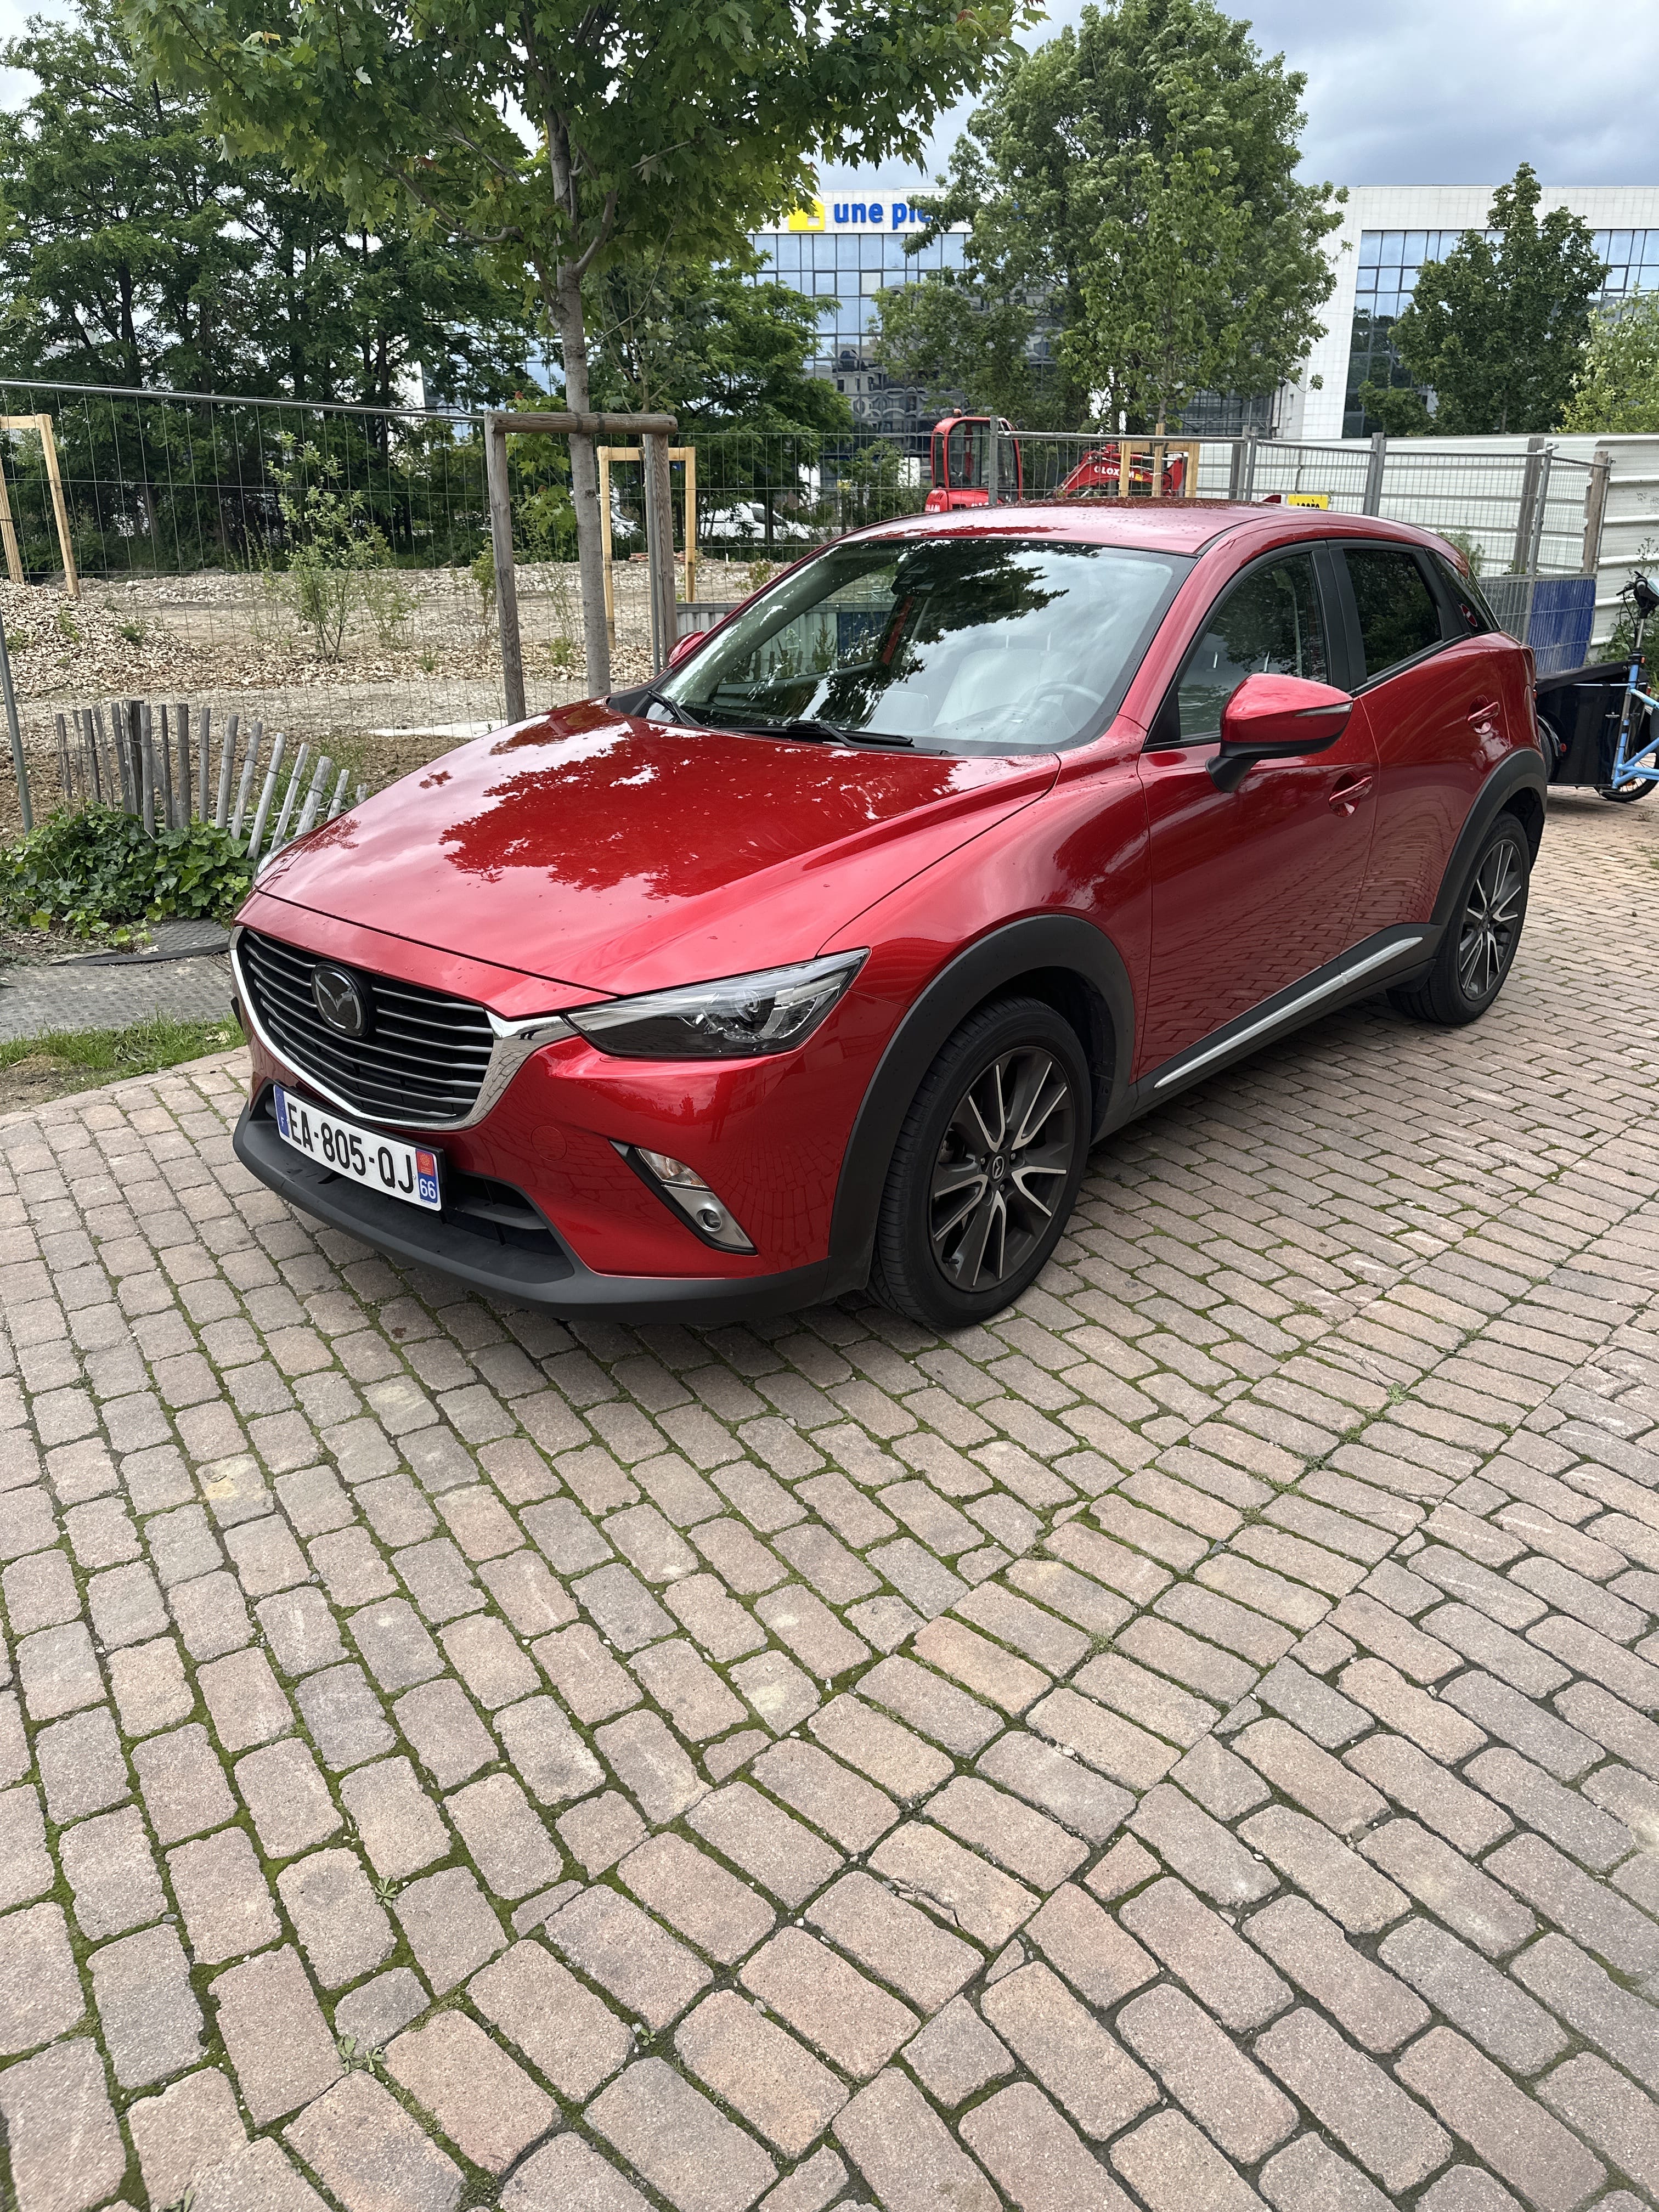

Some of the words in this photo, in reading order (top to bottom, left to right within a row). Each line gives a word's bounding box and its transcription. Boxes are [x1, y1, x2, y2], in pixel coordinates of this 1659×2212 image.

[834, 202, 883, 223] une
[280, 1116, 285, 1127] F
[287, 1102, 414, 1194] EA-805-QJ
[419, 1178, 436, 1199] 66
